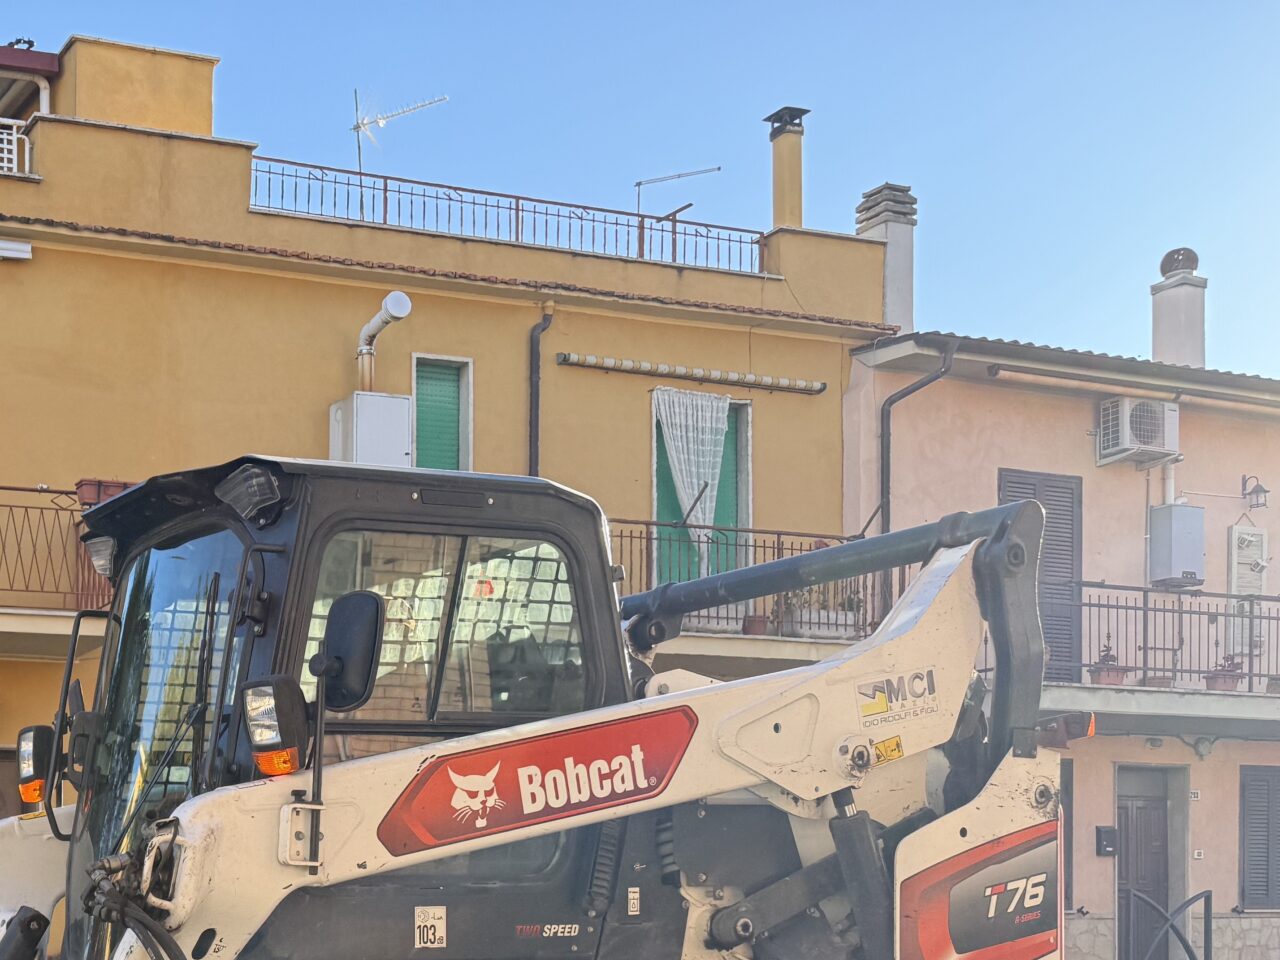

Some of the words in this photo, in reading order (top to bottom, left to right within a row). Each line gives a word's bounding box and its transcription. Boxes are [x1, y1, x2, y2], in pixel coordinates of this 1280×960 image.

[885, 669, 936, 704] MCI
[517, 744, 649, 815] Bobcat
[984, 873, 1047, 918] T76
[416, 924, 437, 945] 103
[543, 924, 580, 937] SPEED
